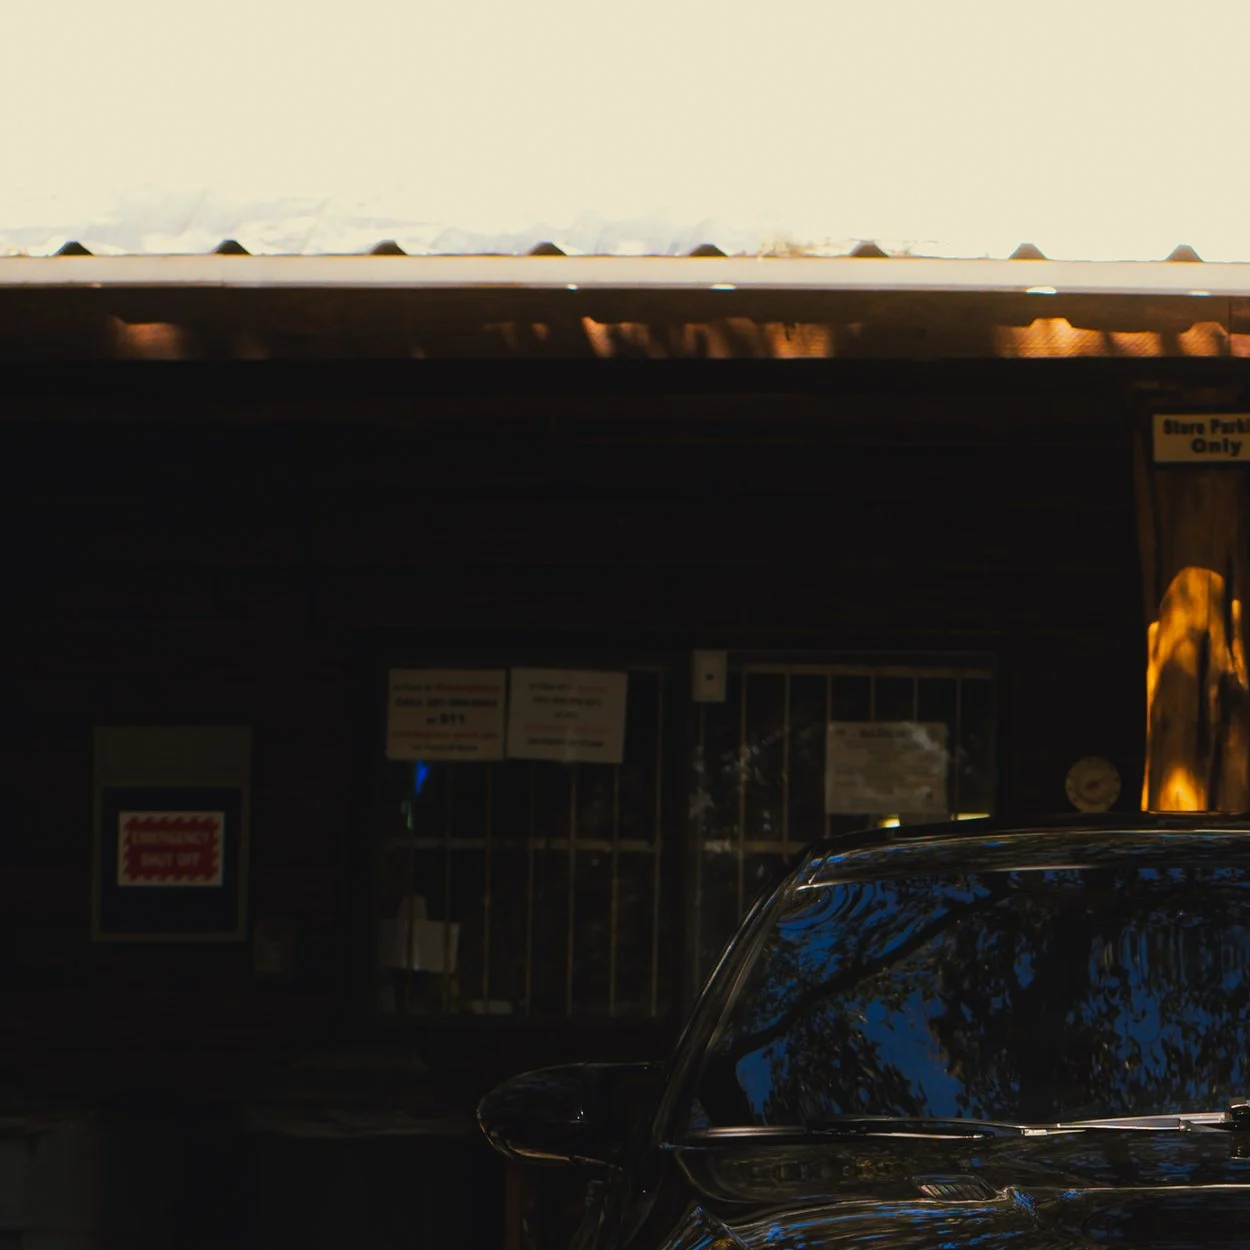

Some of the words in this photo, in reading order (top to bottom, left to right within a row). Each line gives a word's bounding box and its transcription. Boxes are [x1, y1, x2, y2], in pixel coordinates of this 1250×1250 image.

[1163, 419, 1205, 435] Store
[1191, 438, 1242, 457] Only
[131, 831, 210, 845] EMERGENCY
[140, 852, 173, 867] SHUT
[176, 852, 201, 867] OFF
